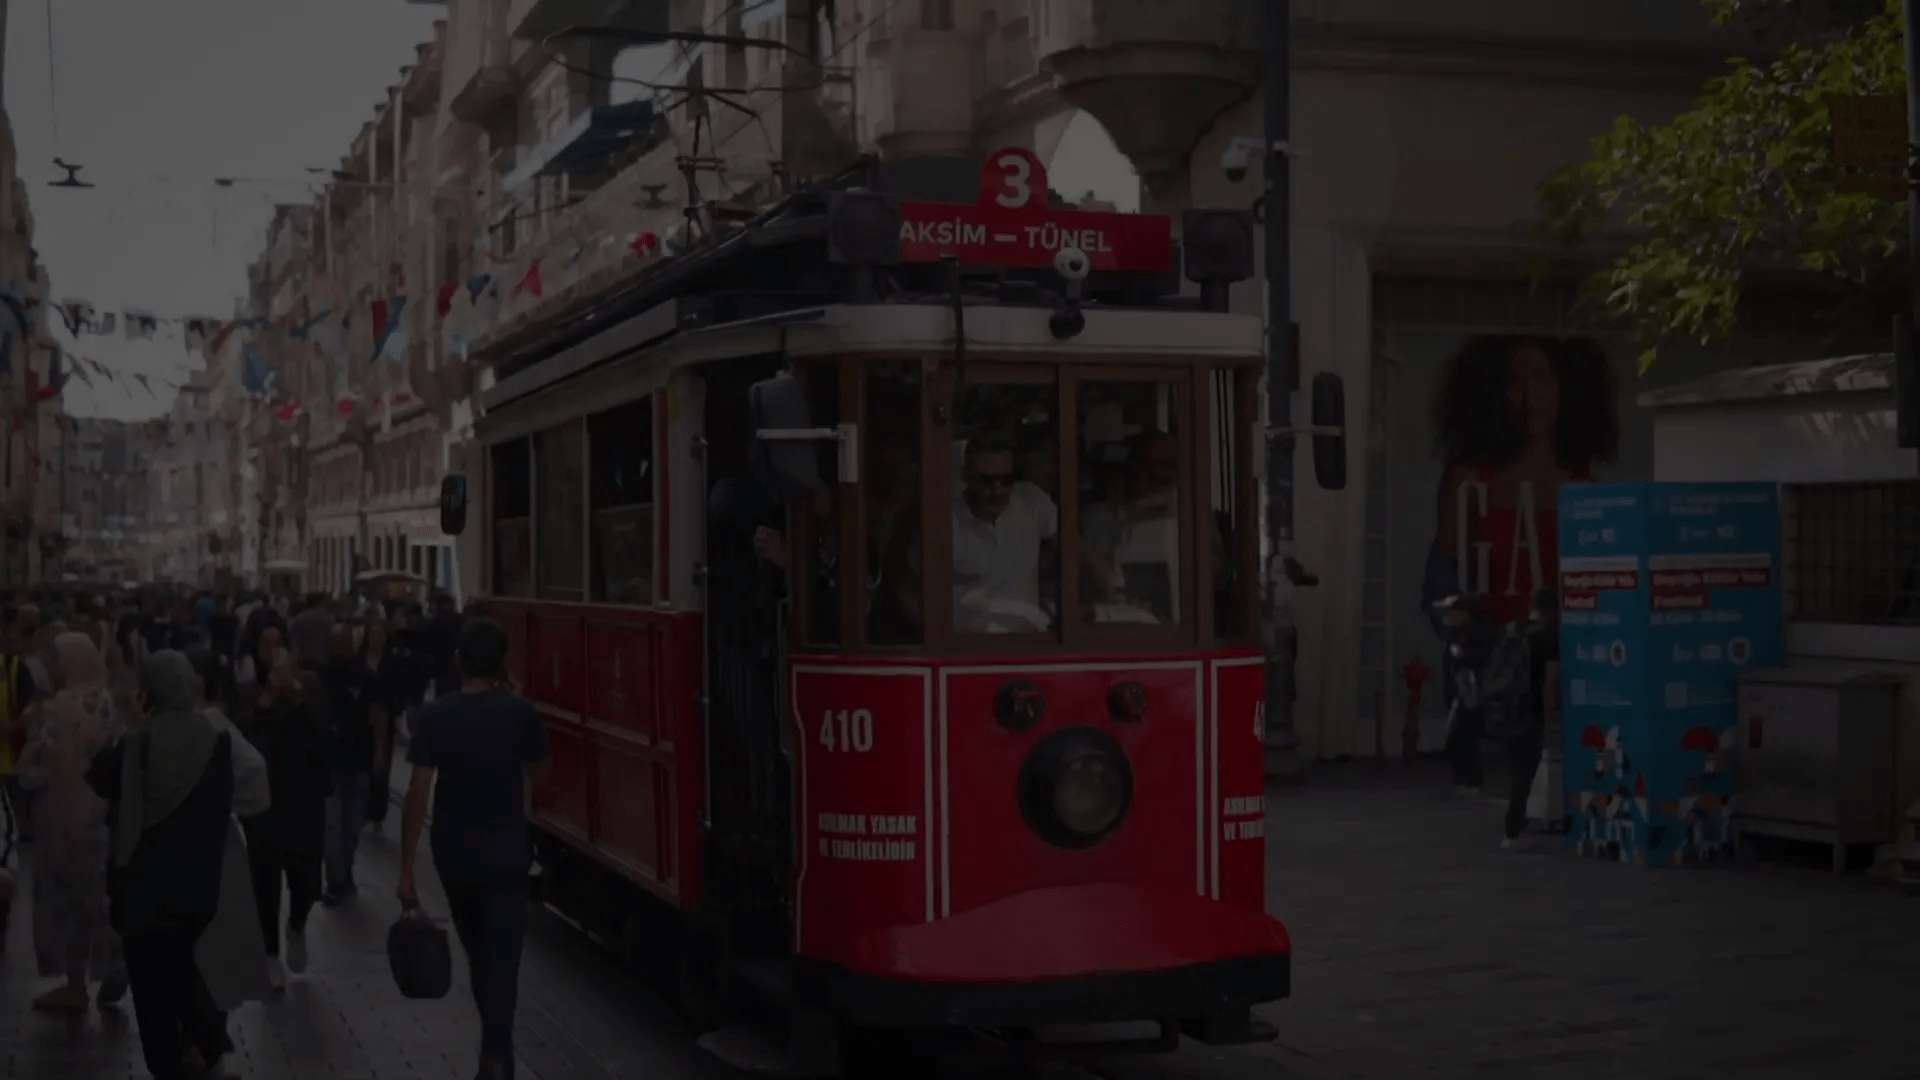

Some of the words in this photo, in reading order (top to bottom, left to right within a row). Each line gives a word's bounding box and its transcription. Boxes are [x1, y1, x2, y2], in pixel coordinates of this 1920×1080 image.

[995, 154, 1031, 208] 3
[900, 216, 987, 245] AKSİM
[1024, 222, 1113, 252] TÜNEL
[1457, 480, 1543, 597] GA
[819, 708, 873, 752] 410
[869, 814, 917, 835] YASAK
